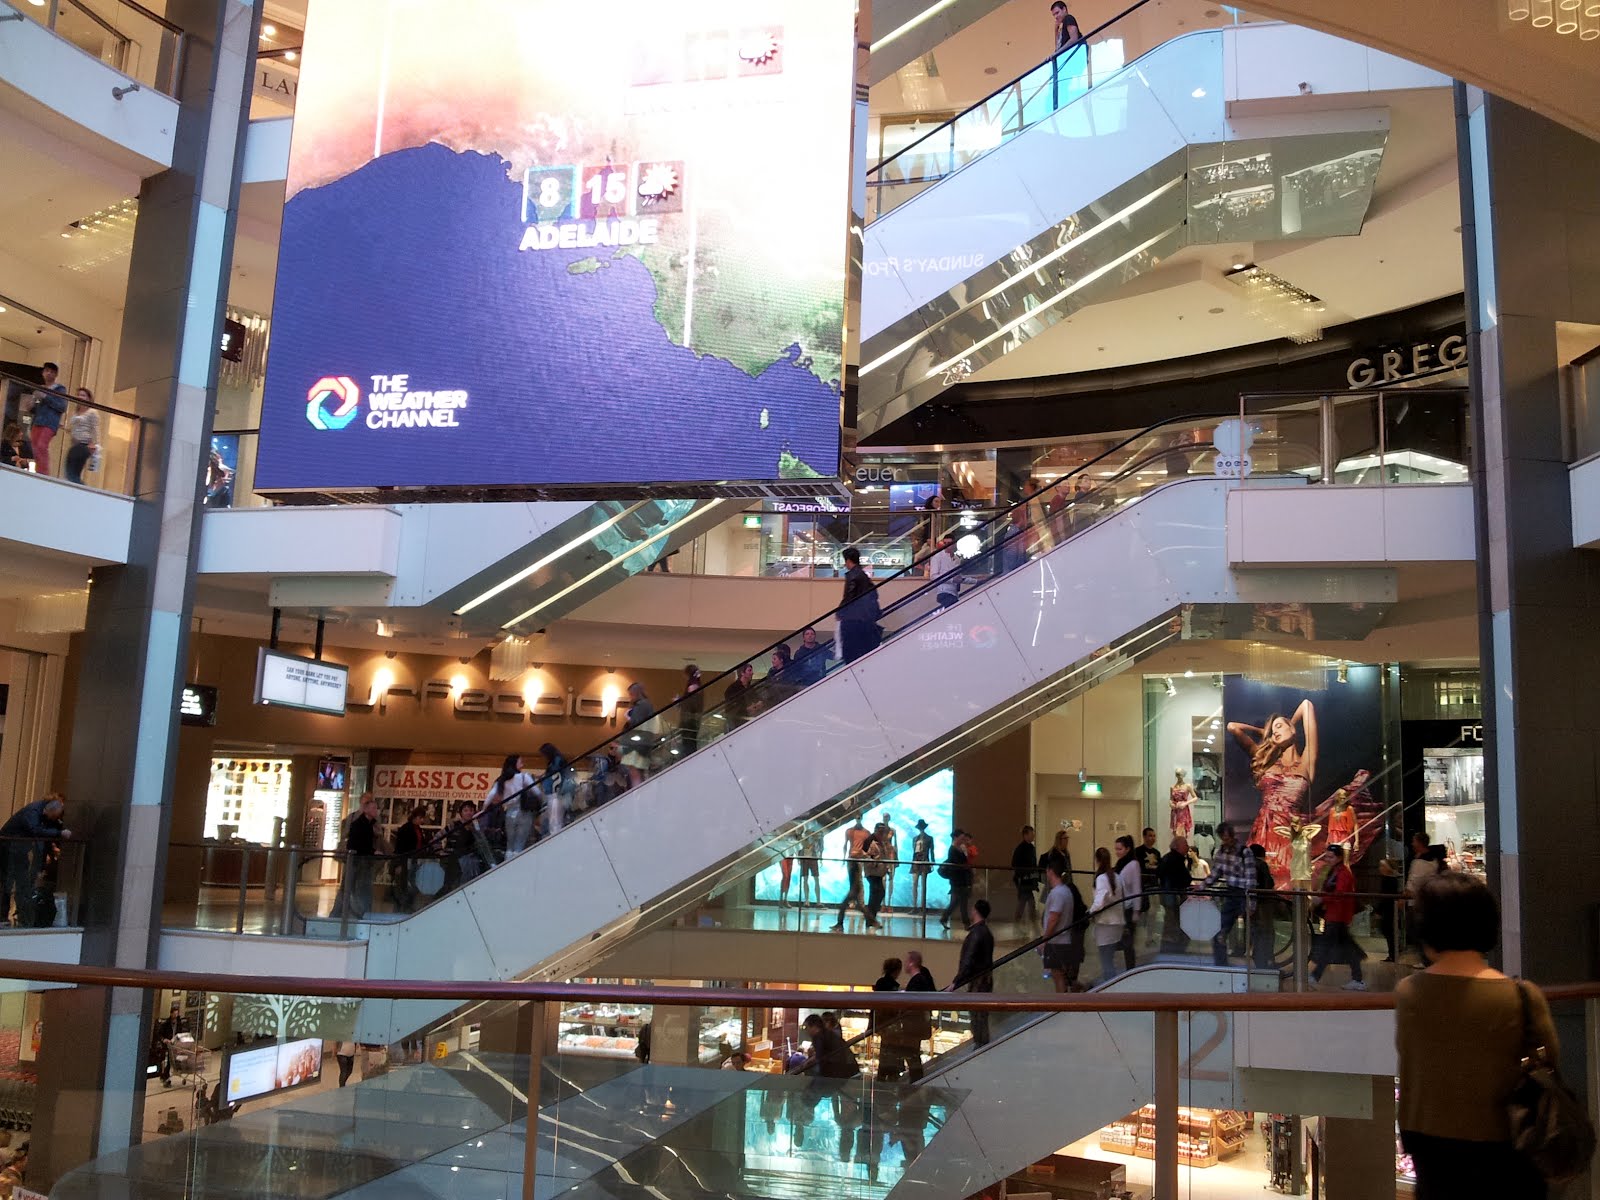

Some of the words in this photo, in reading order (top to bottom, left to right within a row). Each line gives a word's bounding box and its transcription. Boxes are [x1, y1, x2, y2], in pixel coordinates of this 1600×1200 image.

[539, 178, 560, 207] 8
[586, 173, 626, 205] 15
[518, 219, 659, 251] ADELAIDE
[1346, 335, 1467, 388] GREG
[370, 374, 409, 392] THE
[368, 390, 468, 411] WEATHER
[366, 409, 459, 429] CHANNEL
[375, 769, 490, 791] CLASSICS
[452, 791, 472, 799] OWN
